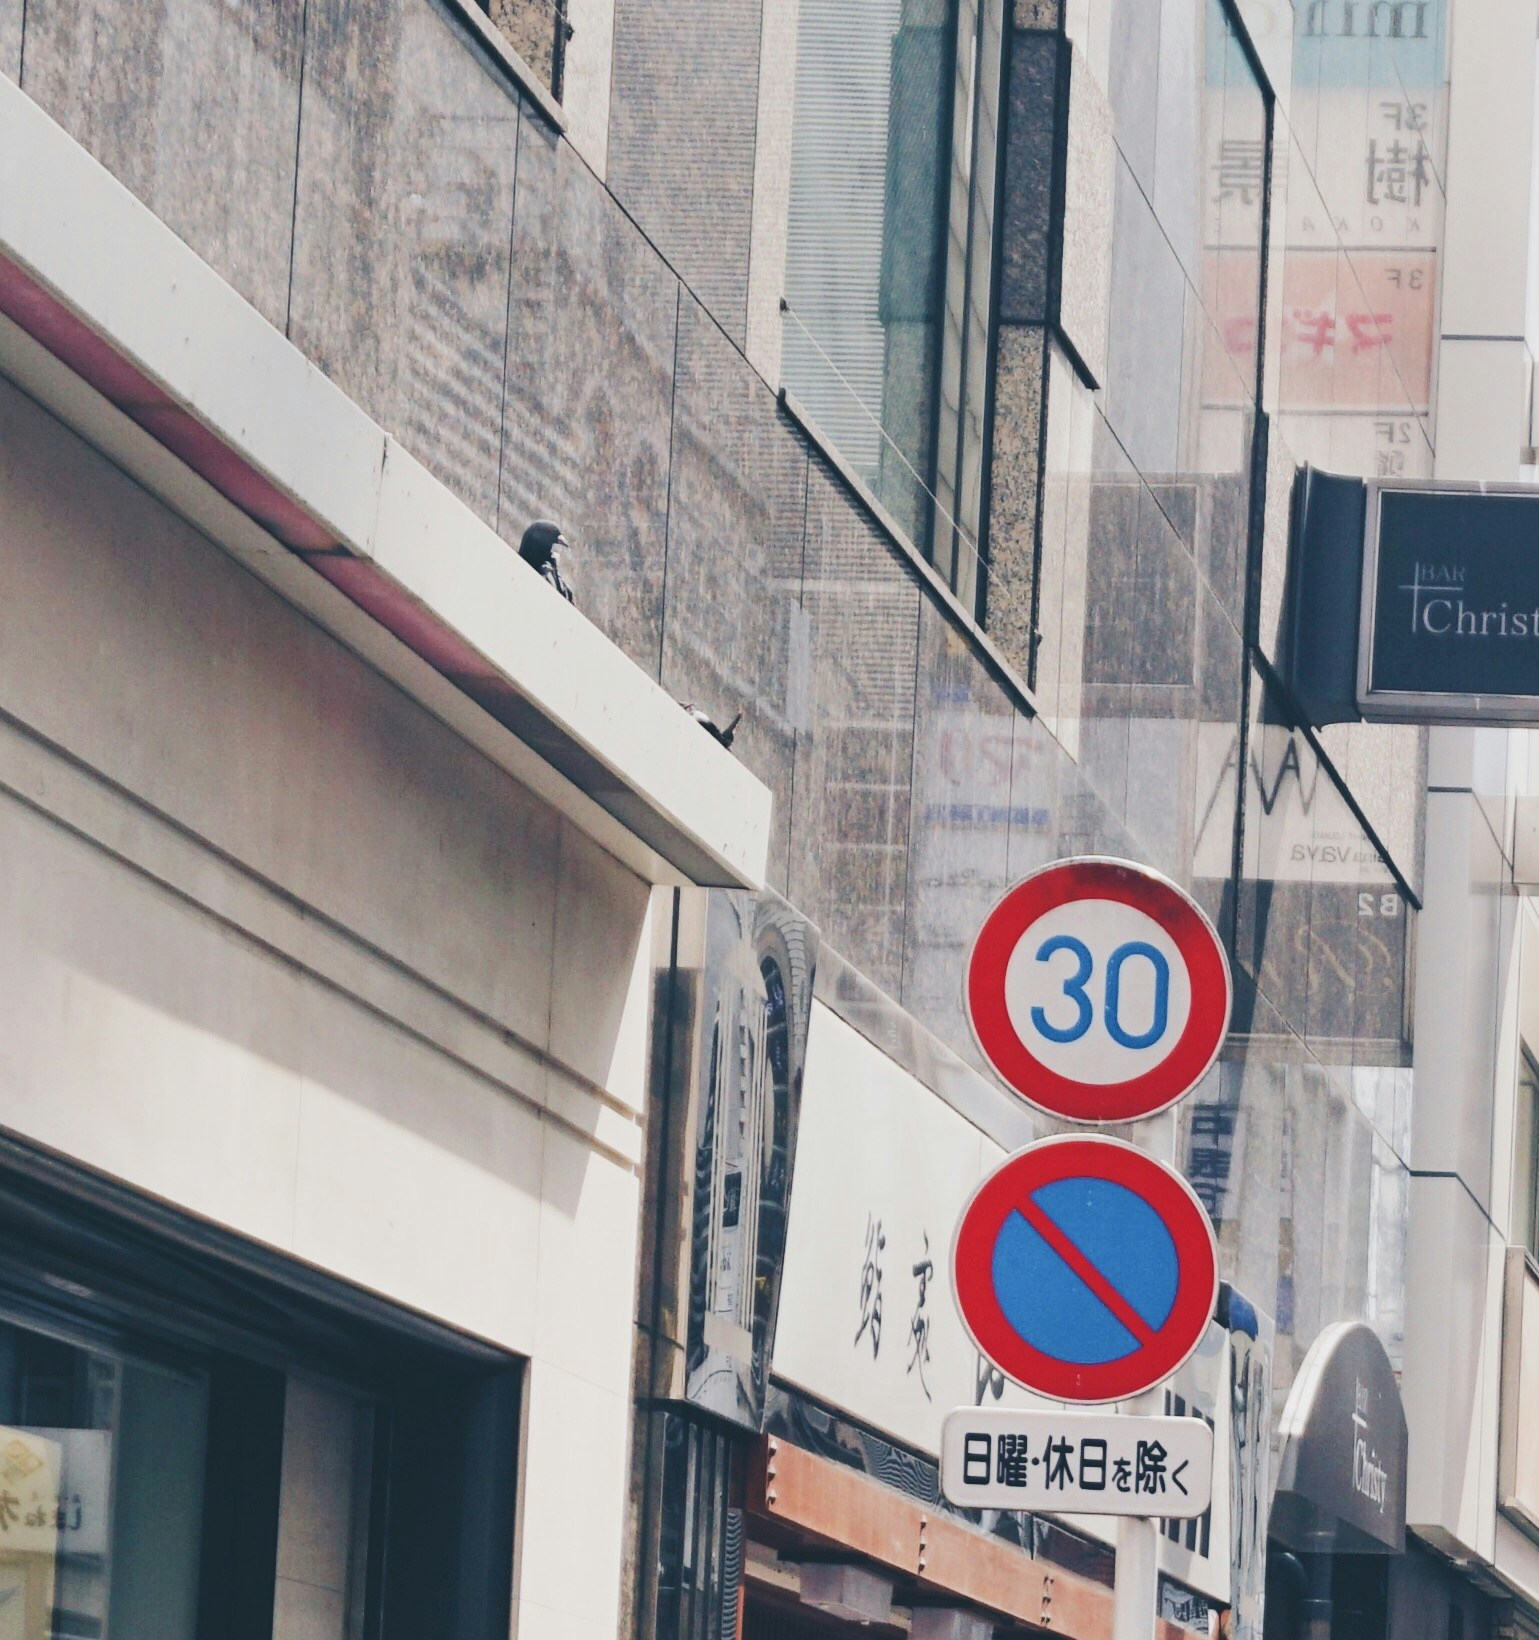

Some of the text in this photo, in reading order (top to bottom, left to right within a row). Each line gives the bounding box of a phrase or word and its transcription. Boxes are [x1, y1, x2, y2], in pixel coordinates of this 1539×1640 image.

[1421, 563, 1466, 583] BAR
[1030, 934, 1169, 1049] 30
[962, 1430, 1189, 1497] 日曜・休日を除く
